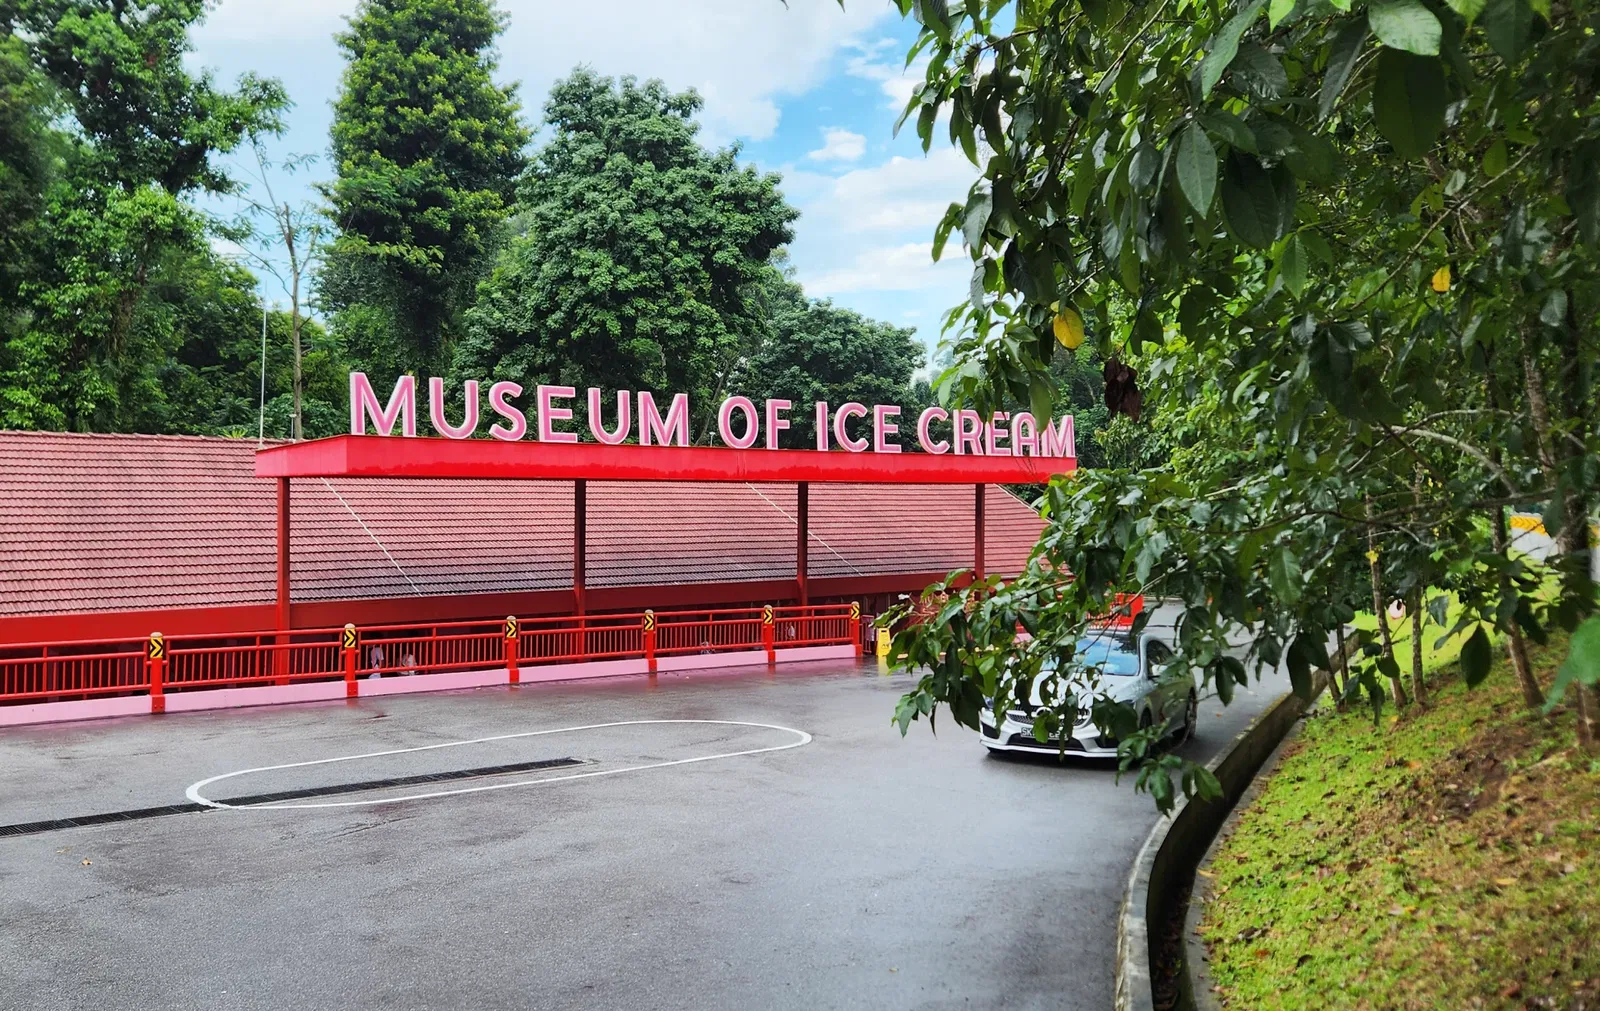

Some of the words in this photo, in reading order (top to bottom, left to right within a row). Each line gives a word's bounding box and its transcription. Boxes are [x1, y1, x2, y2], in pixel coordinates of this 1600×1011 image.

[350, 372, 689, 446] MUSEUM
[718, 396, 791, 450] OF
[816, 401, 901, 453] ICE
[917, 406, 1075, 457] CREAM
